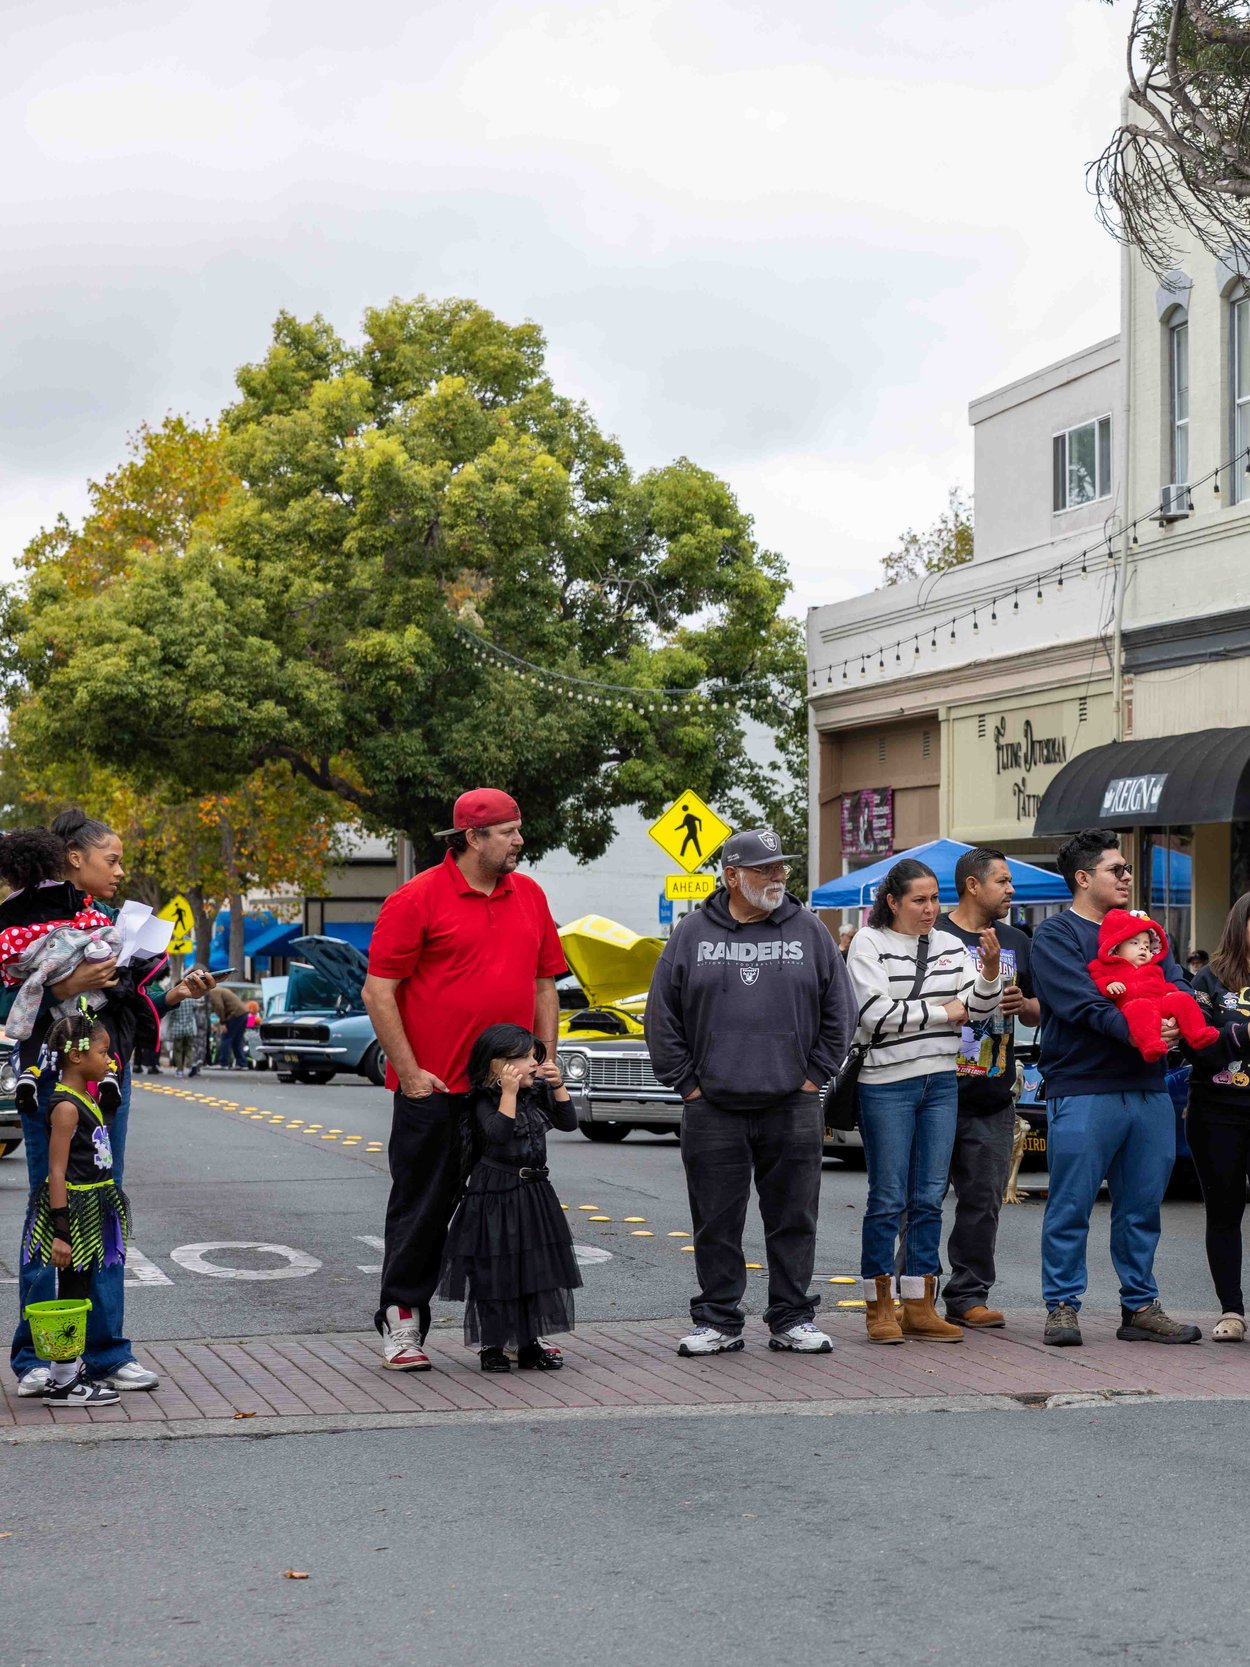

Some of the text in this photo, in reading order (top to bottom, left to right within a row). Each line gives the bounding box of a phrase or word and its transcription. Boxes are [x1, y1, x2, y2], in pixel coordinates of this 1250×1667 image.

[1013, 777, 1041, 821] TATTO
[1111, 777, 1156, 812] REIGN
[672, 882, 709, 893] AHEAD
[697, 941, 804, 962] RAIDERS
